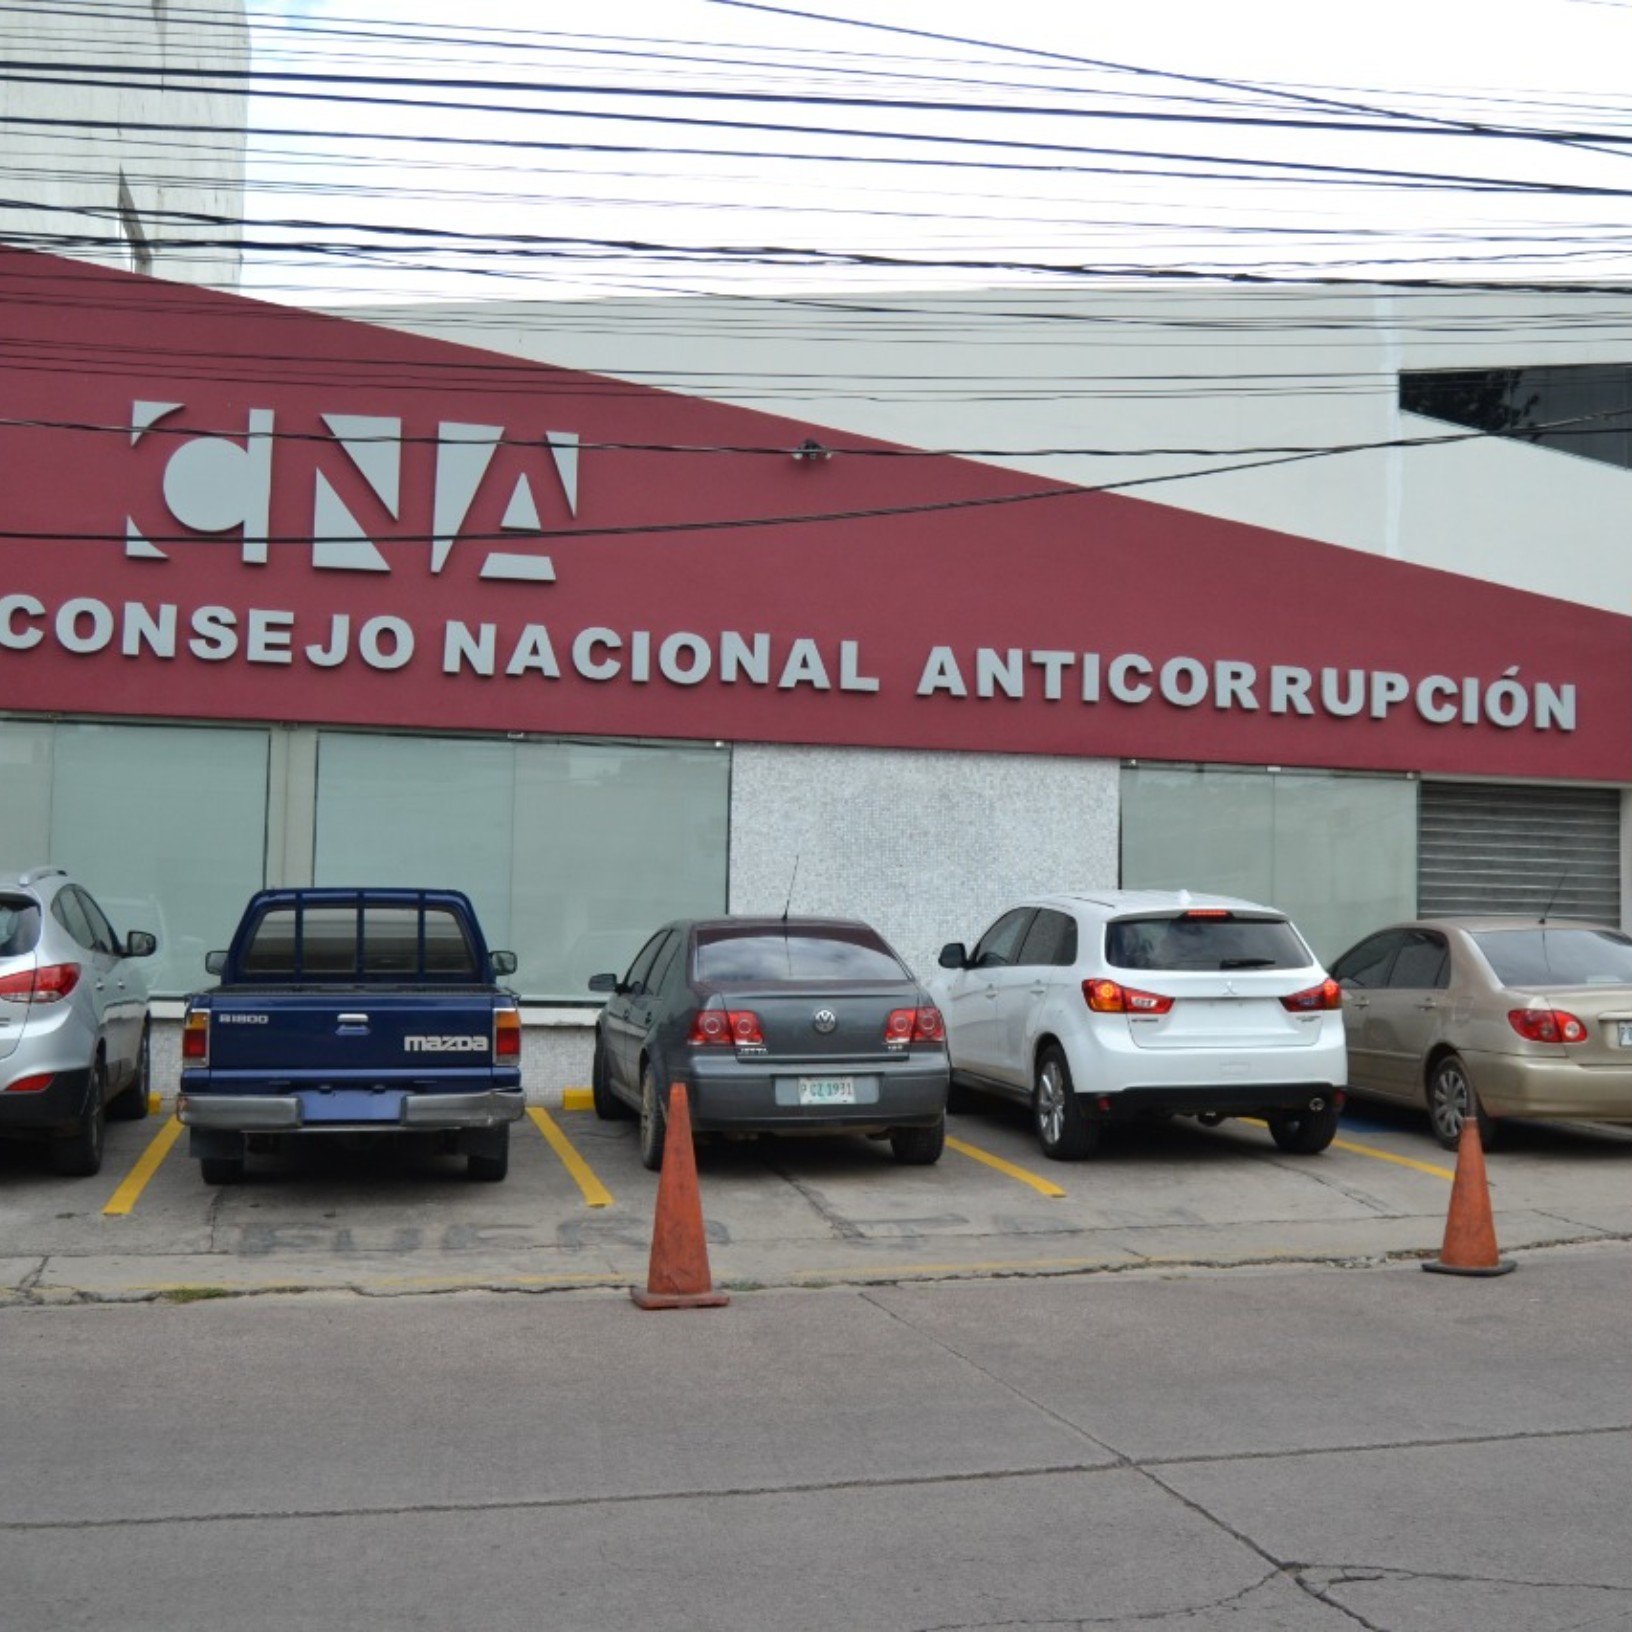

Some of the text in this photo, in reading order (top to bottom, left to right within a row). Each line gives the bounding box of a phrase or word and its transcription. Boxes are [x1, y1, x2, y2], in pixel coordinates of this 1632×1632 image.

[0, 593, 1577, 731] CONSEJO NACIONAL ANTICORRUPCIÓN
